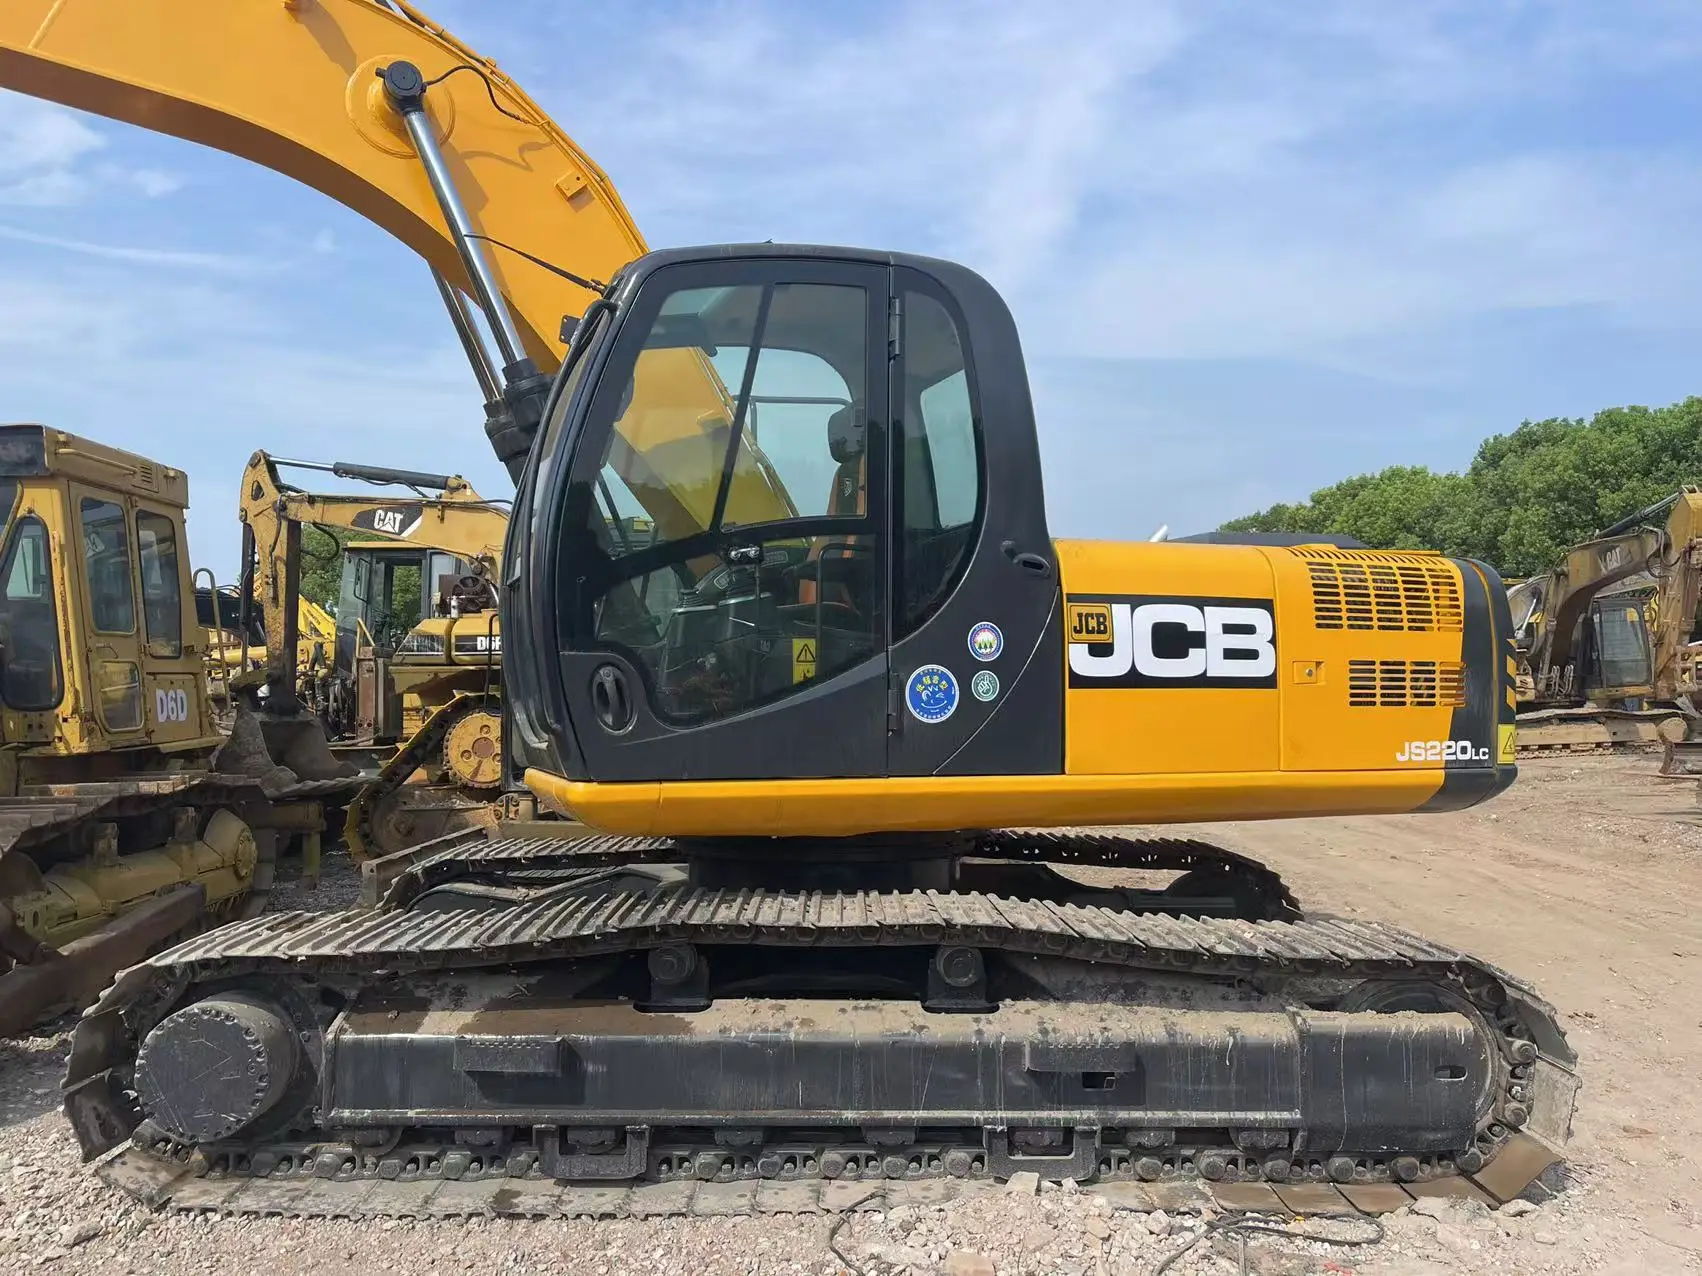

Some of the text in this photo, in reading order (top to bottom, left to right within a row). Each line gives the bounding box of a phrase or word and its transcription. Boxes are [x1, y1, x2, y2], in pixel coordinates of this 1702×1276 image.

[373, 509, 403, 533] CAT
[1073, 612, 1108, 635] JCB
[1068, 603, 1276, 678] JCB
[156, 688, 188, 722] D6D
